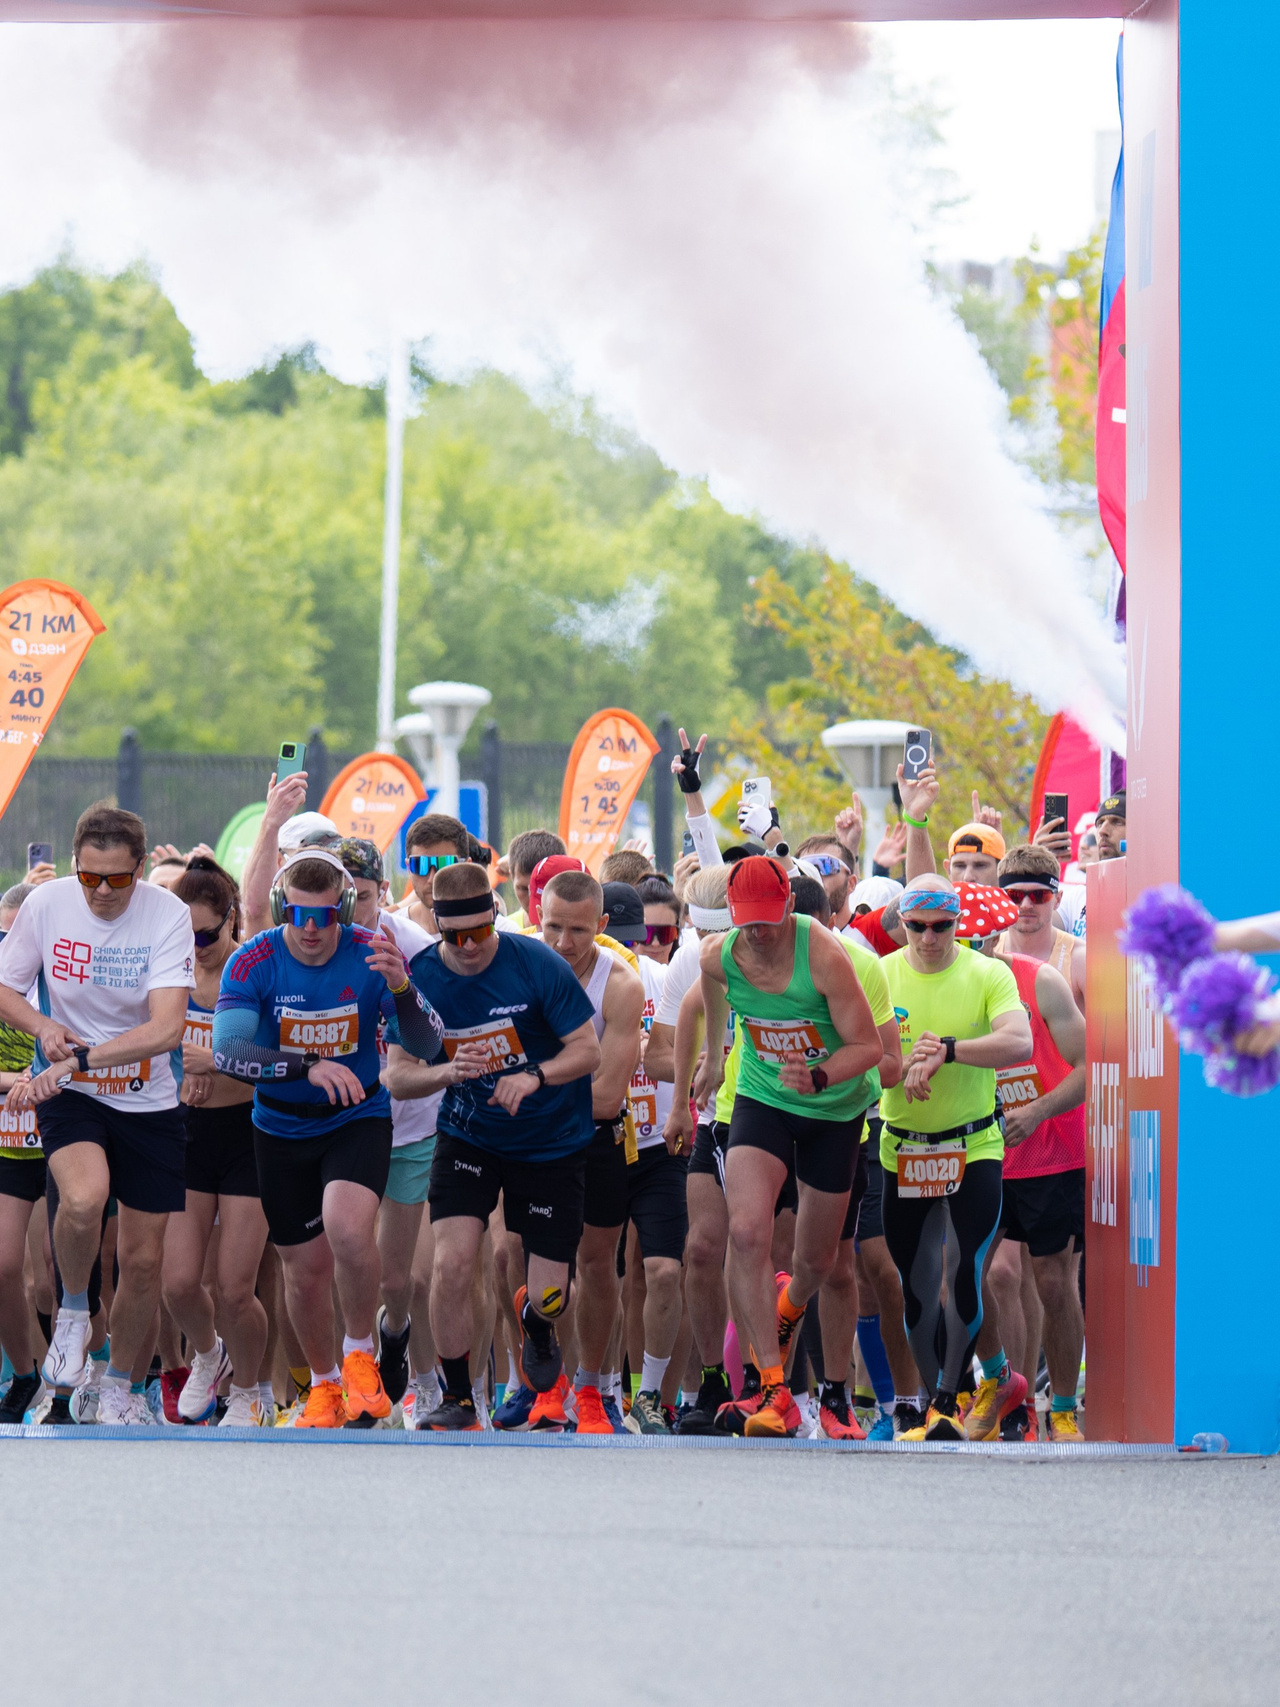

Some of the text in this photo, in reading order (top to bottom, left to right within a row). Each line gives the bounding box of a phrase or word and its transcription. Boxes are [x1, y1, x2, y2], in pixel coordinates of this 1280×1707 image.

[8, 610, 33, 632] 21
[8, 670, 43, 684] 4:45
[8, 687, 45, 709] 40
[11, 714, 43, 724] МИНУТ
[53, 938, 92, 965] 20
[93, 946, 151, 956] CHINA COAST
[93, 955, 146, 965] MARATHON
[52, 960, 90, 985] 24
[275, 994, 306, 1004] LUKOIL
[289, 1021, 349, 1045] 40387
[760, 1030, 813, 1051] 40271
[214, 1052, 288, 1079] SPORTS
[131, 1078, 142, 1089] A
[27, 1133, 37, 1144] A
[904, 1157, 960, 1182] 40020
[530, 1205, 551, 1217] HARD
